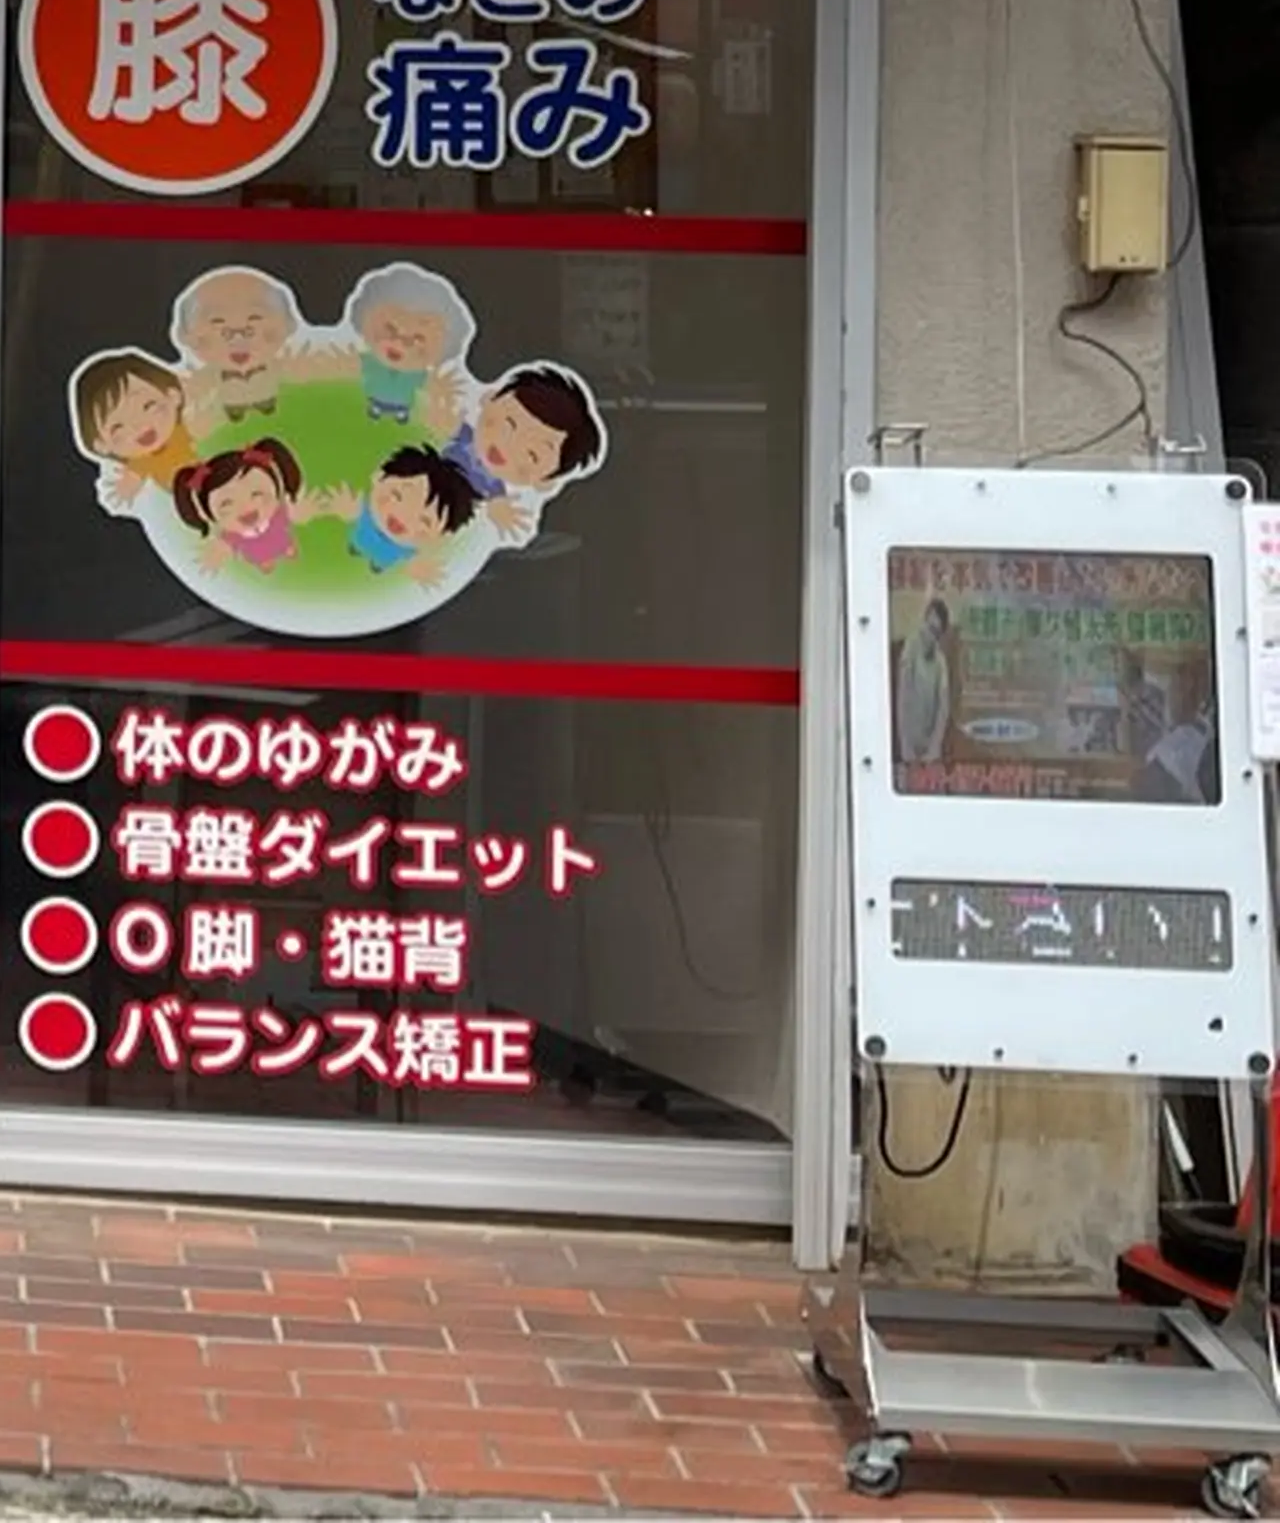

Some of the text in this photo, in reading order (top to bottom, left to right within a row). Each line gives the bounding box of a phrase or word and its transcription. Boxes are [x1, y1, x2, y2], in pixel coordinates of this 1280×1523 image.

[370, 33, 650, 169] 痛み
[114, 712, 465, 791] 体のゆがみ
[114, 809, 597, 893] 骨盤ダイエット
[111, 999, 533, 1087] バランス矯正
